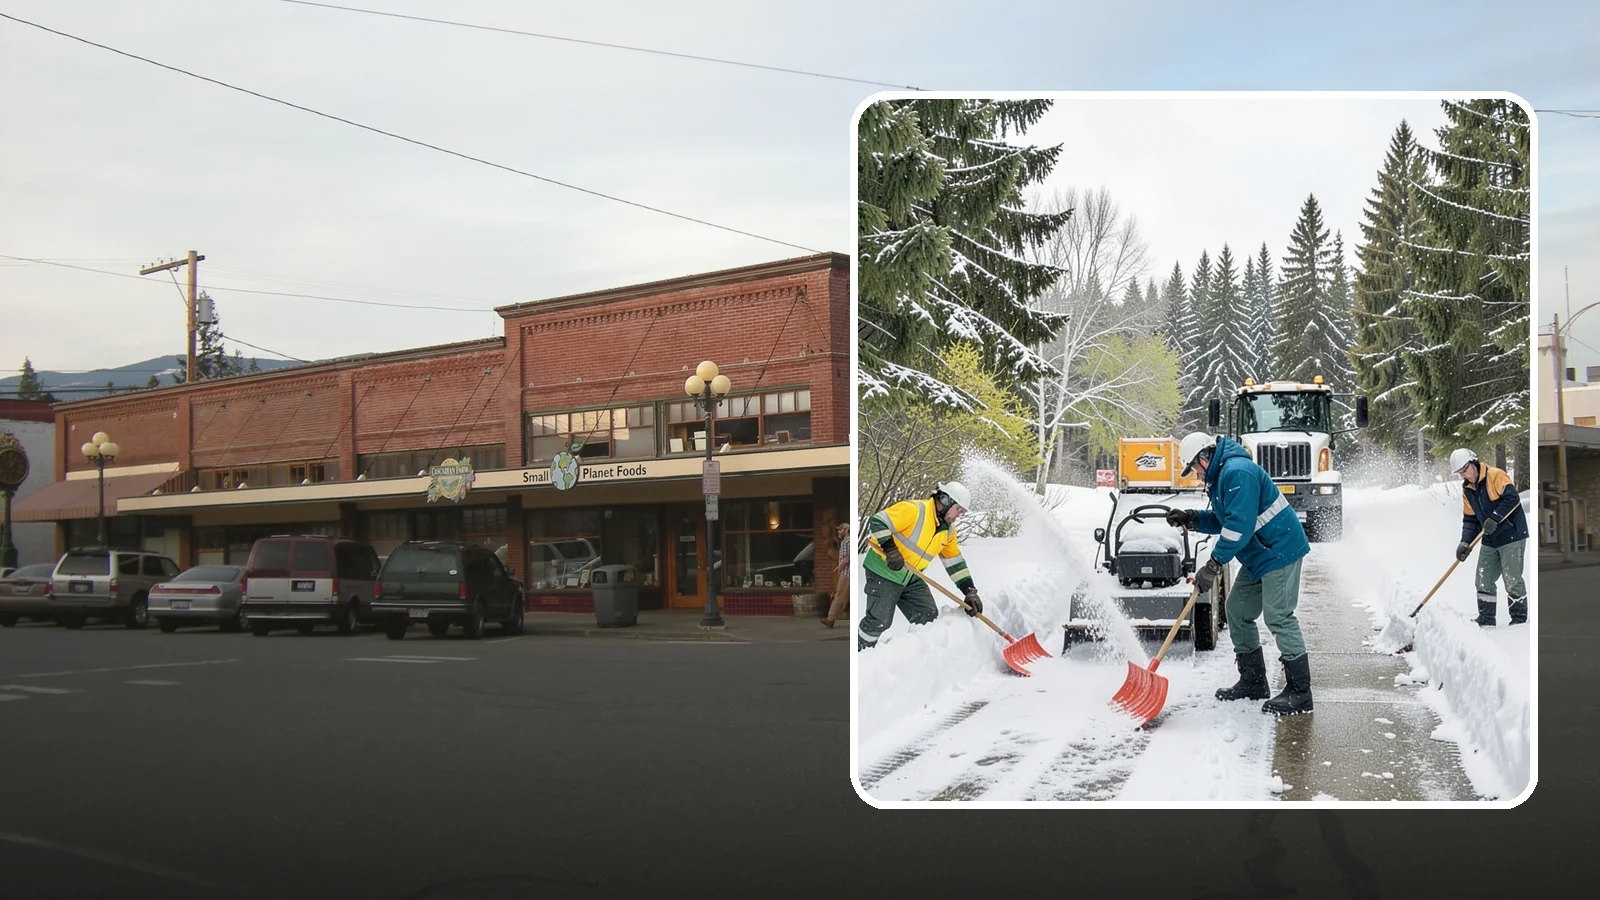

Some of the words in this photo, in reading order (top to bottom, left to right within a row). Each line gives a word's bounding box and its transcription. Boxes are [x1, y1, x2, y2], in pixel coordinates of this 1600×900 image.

[523, 471, 549, 483] Small
[583, 467, 614, 479] Planet
[617, 464, 647, 477] Foods
